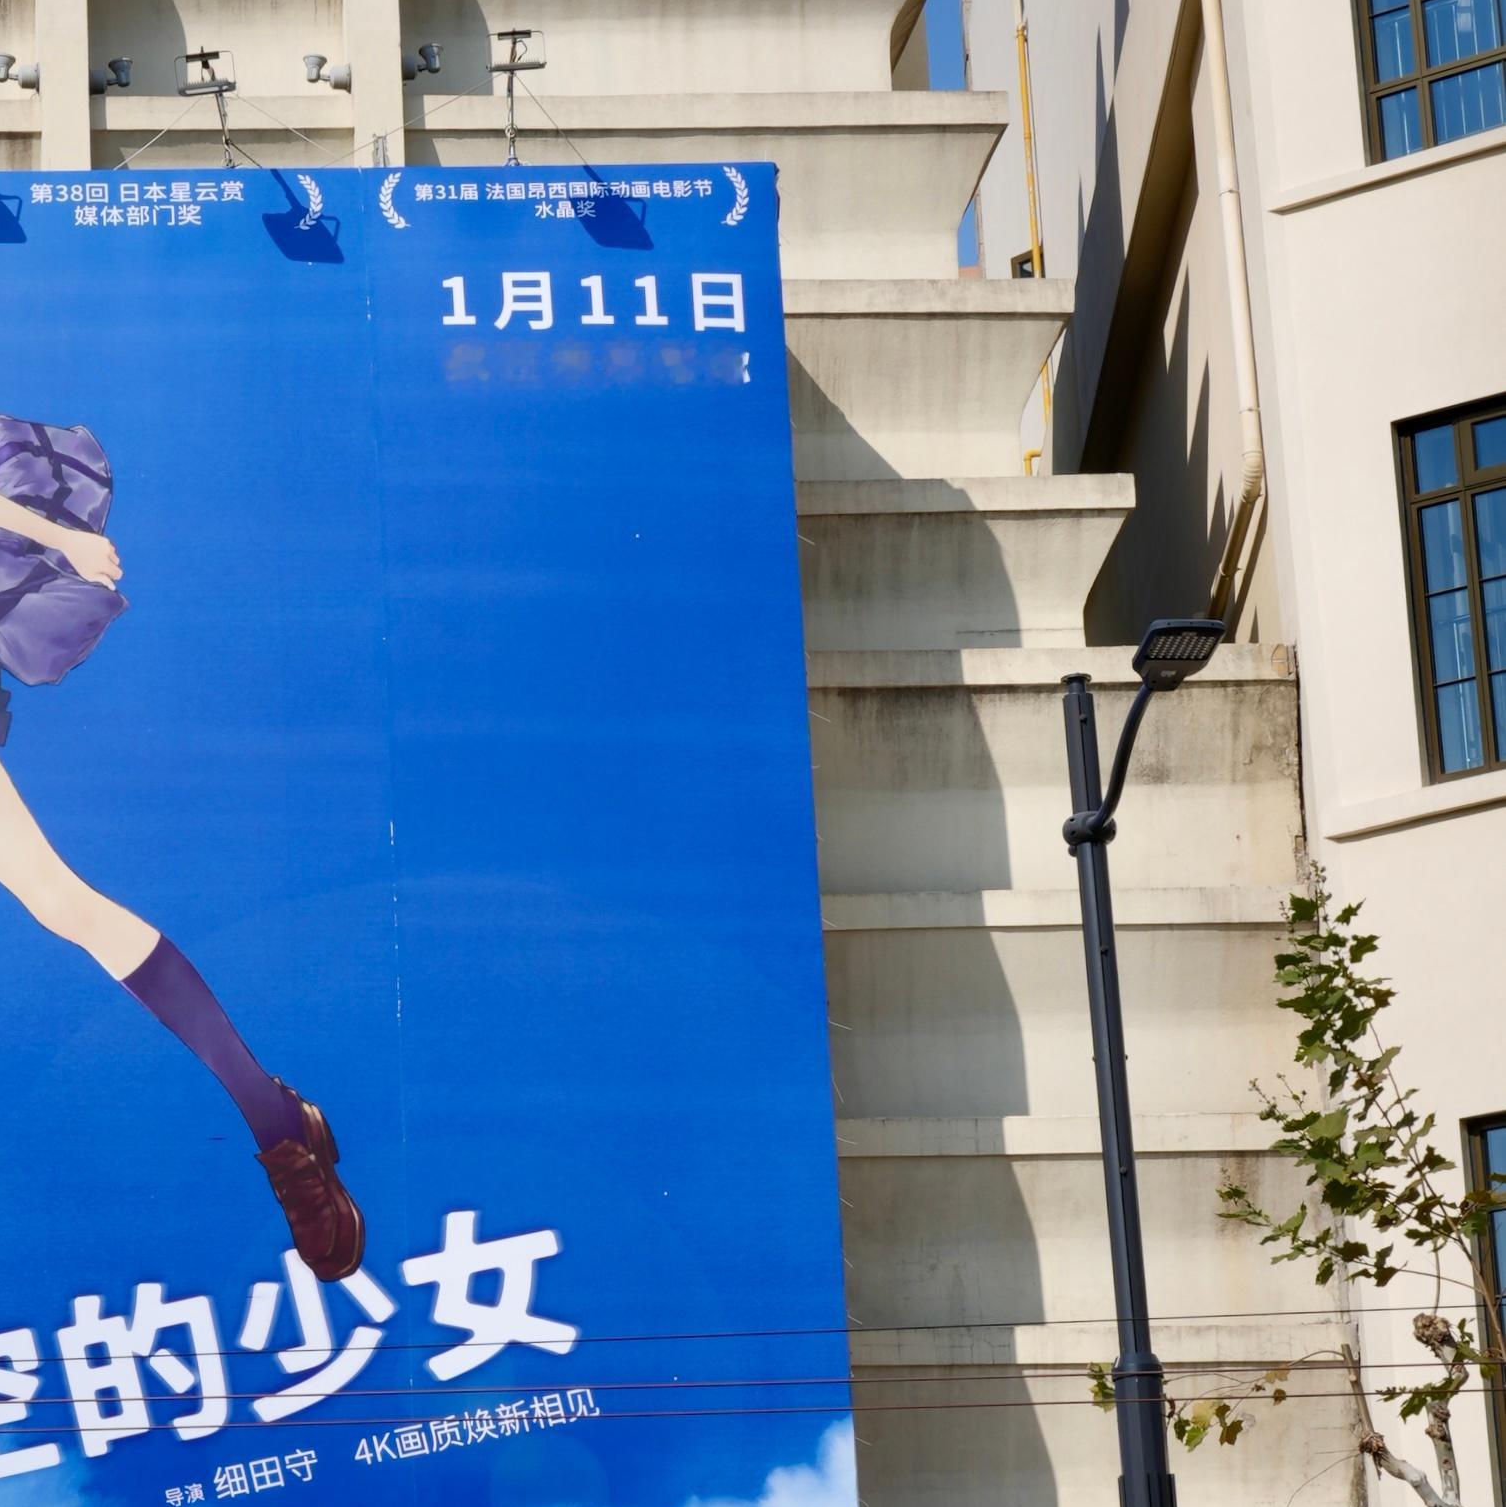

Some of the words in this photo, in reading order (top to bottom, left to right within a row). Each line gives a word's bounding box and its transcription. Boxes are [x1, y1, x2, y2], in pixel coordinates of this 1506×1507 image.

[30, 182, 110, 204] 第38回
[119, 180, 245, 203] 日本星云赏
[414, 183, 479, 201] 第31届
[485, 179, 713, 201] 法国昂西国际动画电影节
[74, 204, 203, 227] 媒体部门奖
[534, 200, 597, 219] 水晶奖
[441, 271, 746, 333] 1月11日
[164, 1483, 206, 1507] 导演
[213, 1448, 319, 1500] 细田守
[354, 1388, 601, 1466] 4K画质焕新相见
